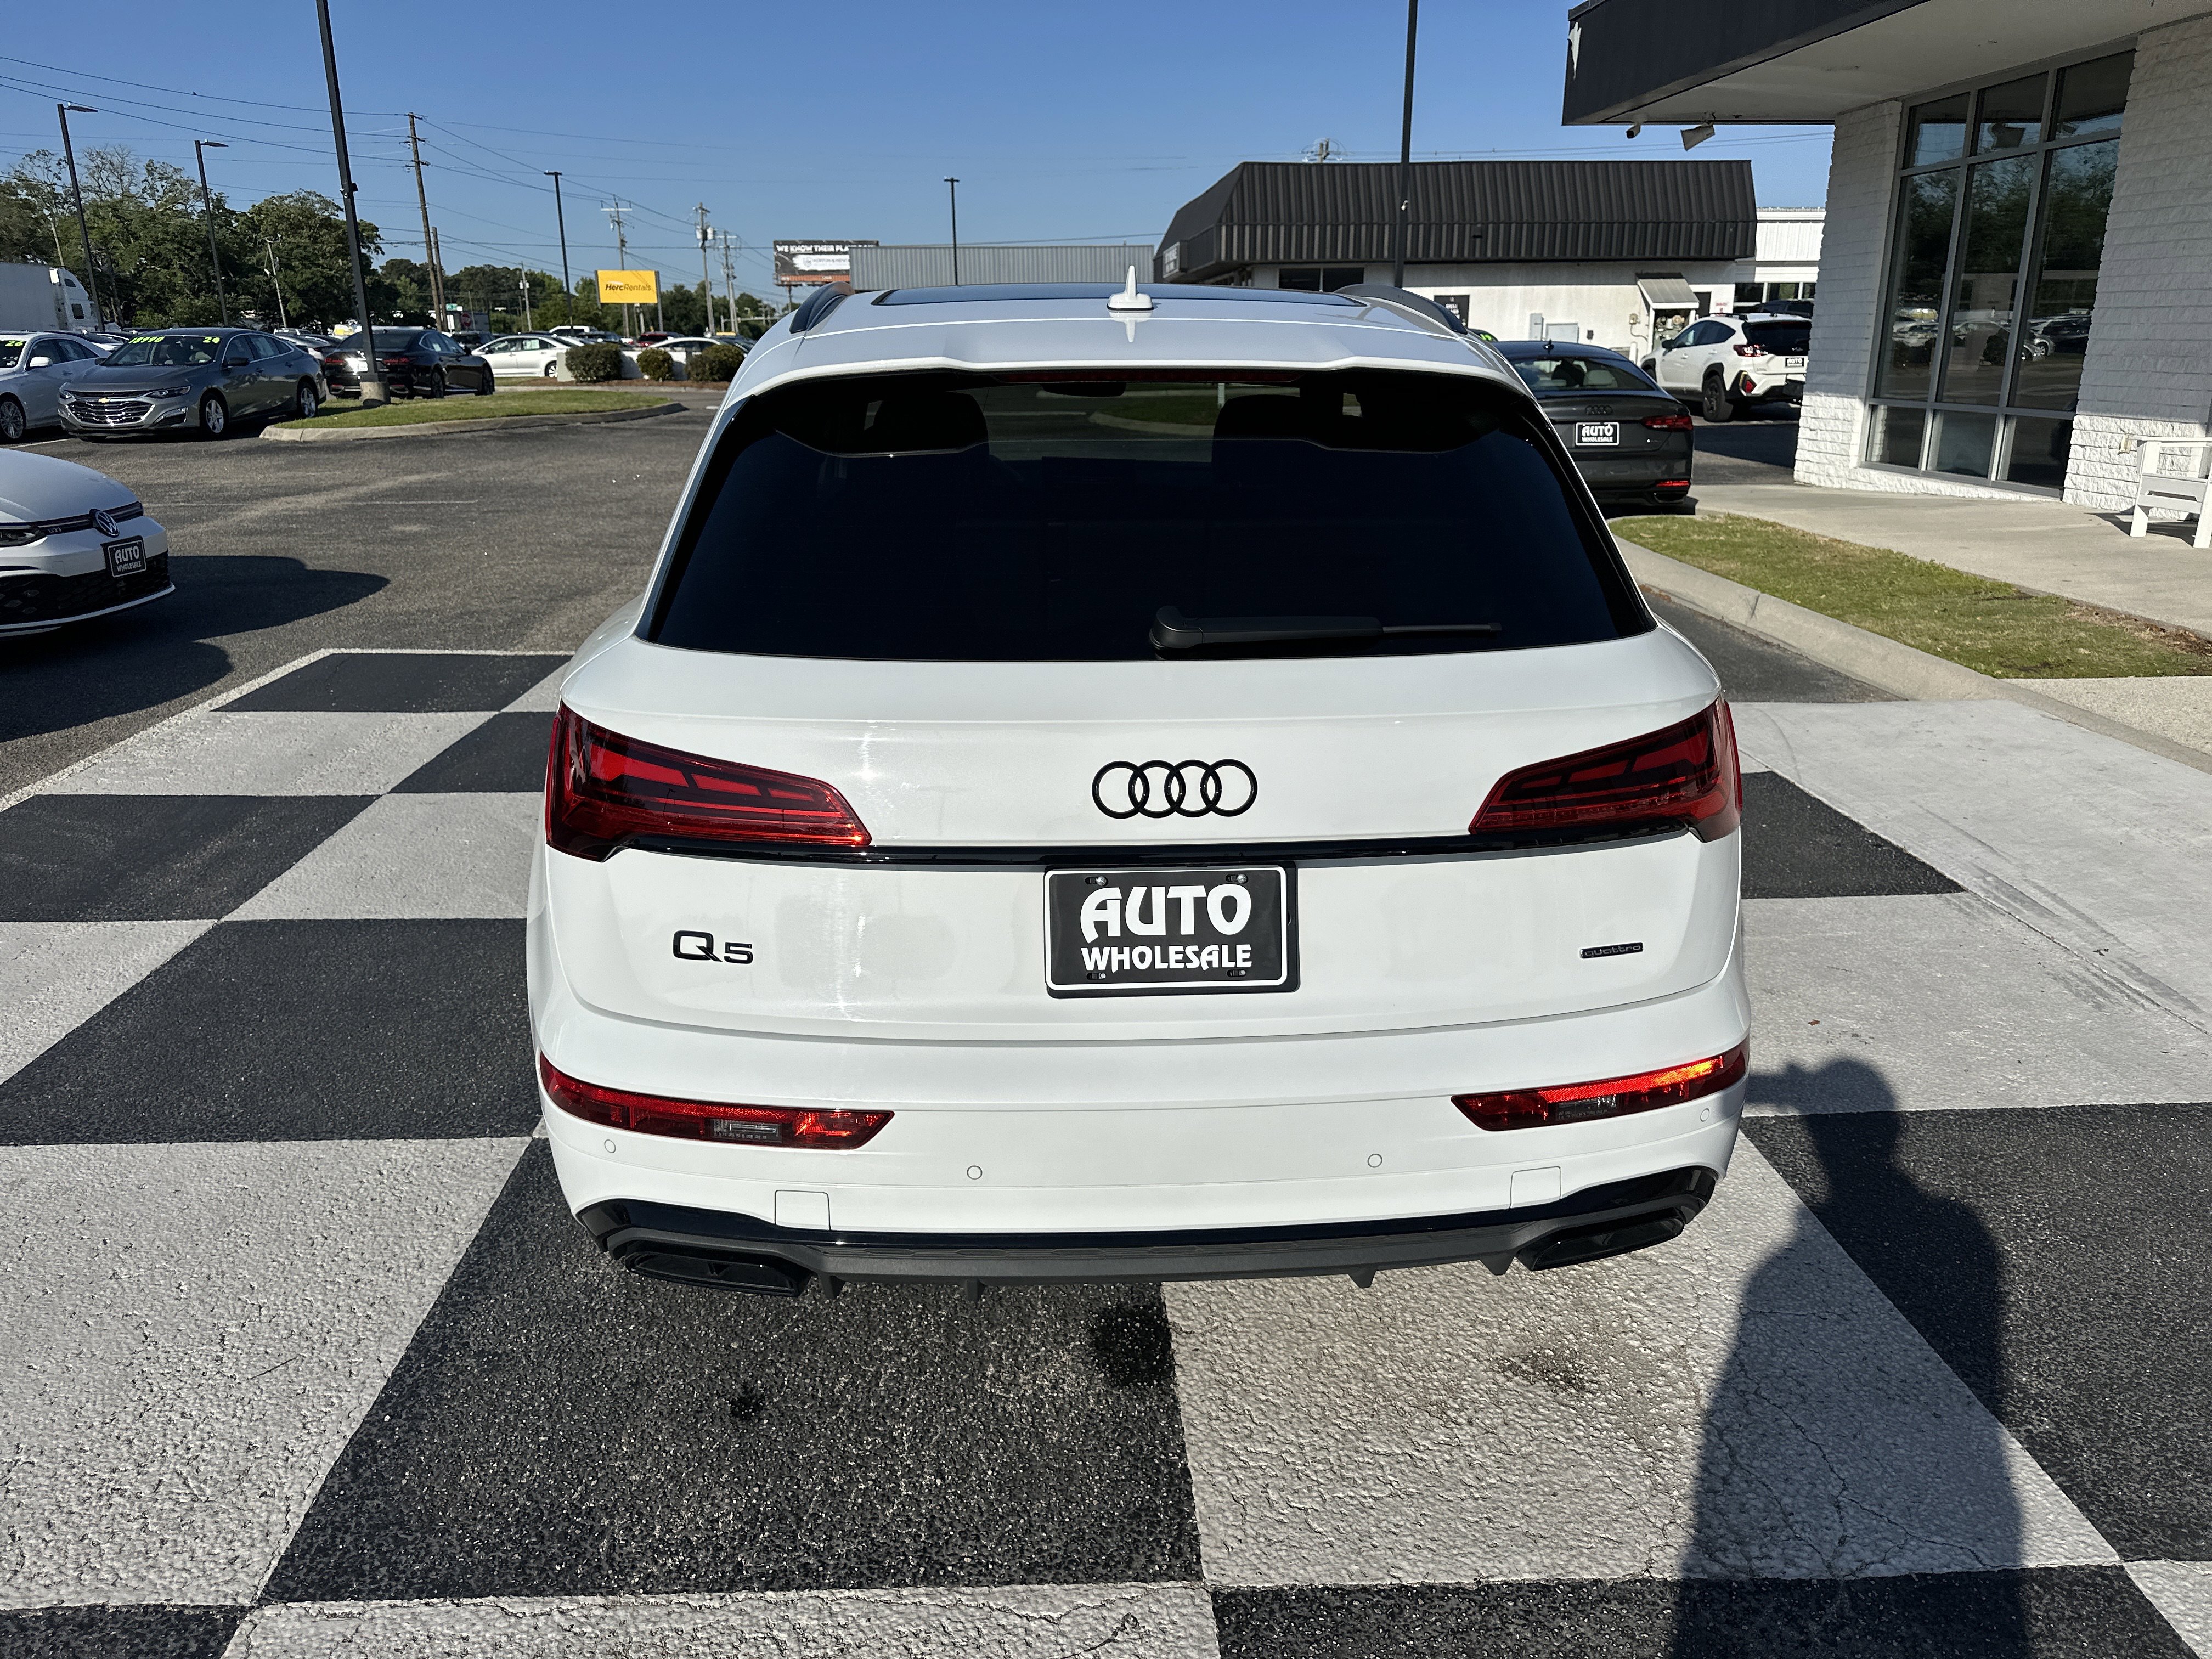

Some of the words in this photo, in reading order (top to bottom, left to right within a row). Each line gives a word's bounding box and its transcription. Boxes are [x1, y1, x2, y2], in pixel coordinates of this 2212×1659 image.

[1581, 425, 1614, 437] AUTO
[115, 545, 140, 565] AUTO
[116, 560, 142, 572] WHOLESALE
[1080, 884, 1251, 944] AUTO
[673, 930, 753, 964] Q5
[1584, 945, 1641, 957] quattro
[1081, 944, 1252, 973] WHOLESALE
